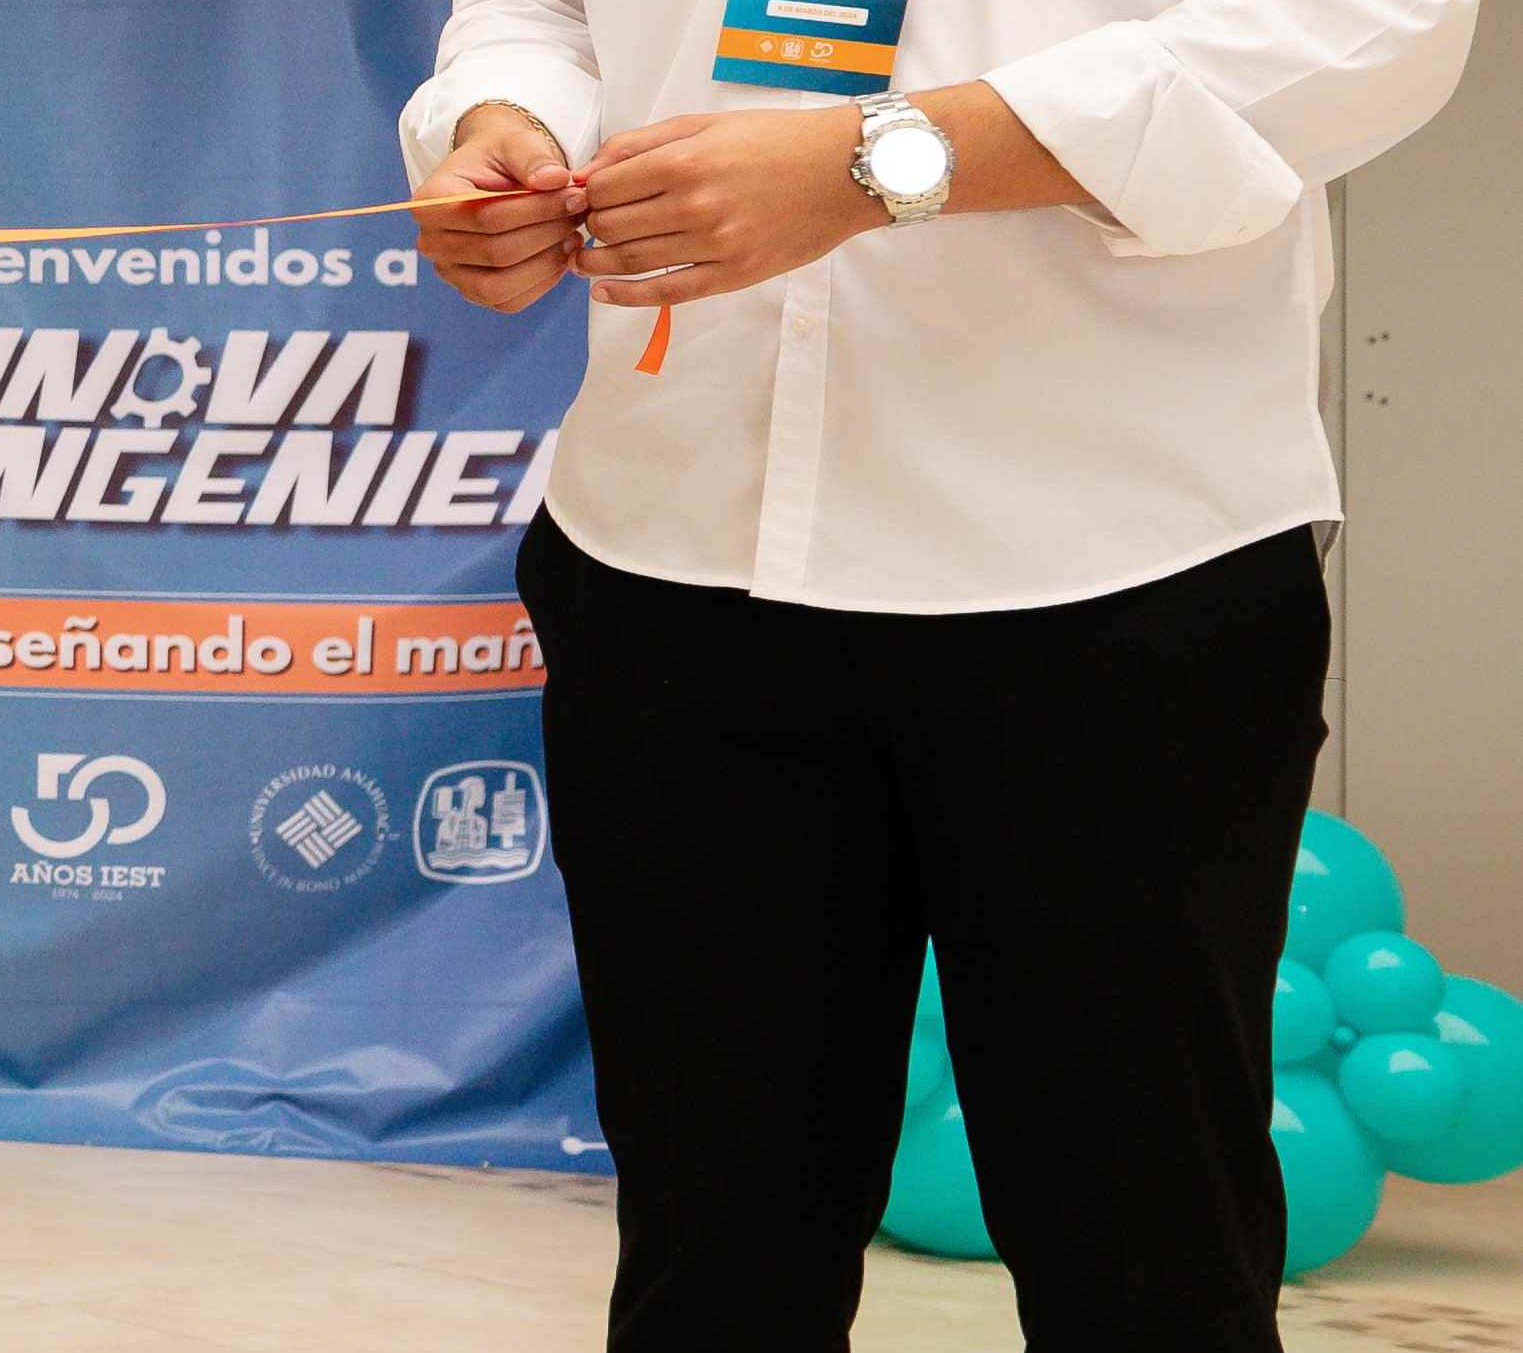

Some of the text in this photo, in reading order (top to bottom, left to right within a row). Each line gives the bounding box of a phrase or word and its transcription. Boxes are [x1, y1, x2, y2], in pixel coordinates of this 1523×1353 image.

[373, 248, 418, 286] a
[312, 617, 372, 674] el
[397, 615, 545, 675] mañ
[11, 753, 167, 858] 50
[9, 859, 166, 888] AÑOS IEST
